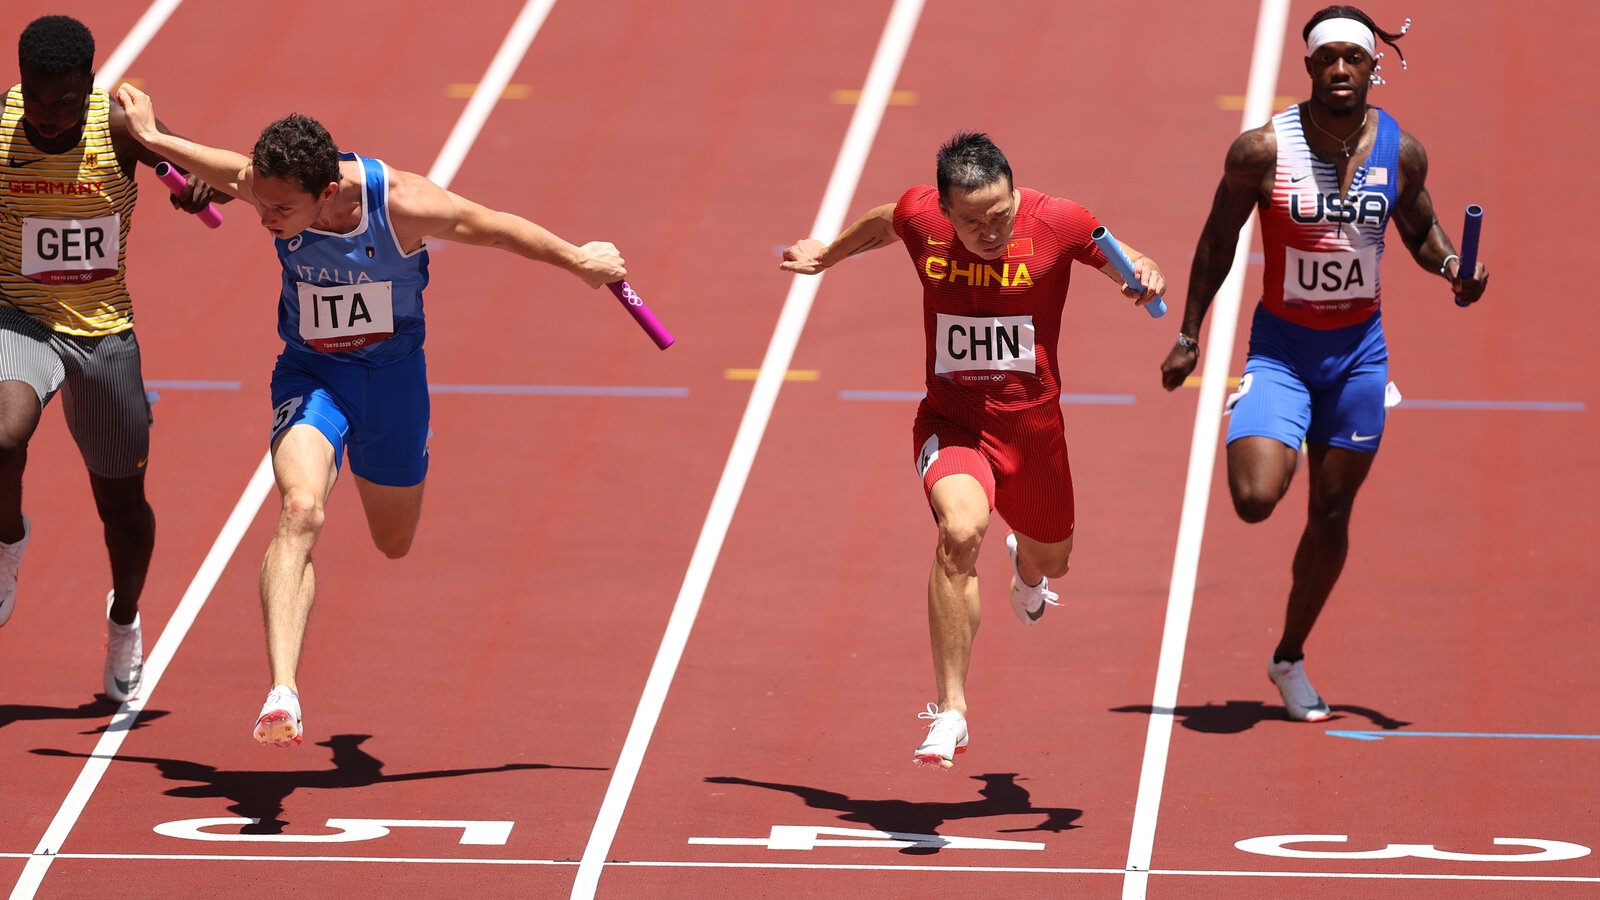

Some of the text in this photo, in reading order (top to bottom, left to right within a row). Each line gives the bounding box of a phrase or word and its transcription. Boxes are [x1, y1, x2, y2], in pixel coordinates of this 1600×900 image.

[9, 180, 104, 195] GERMANY
[1290, 192, 1388, 225] USA
[37, 226, 105, 262] GER
[296, 264, 373, 284] ITALIA
[925, 255, 1034, 287] CHINA
[1298, 258, 1364, 292] USA
[312, 292, 372, 329] ITA
[947, 324, 1020, 361] CHN
[273, 401, 292, 432] 5
[153, 817, 515, 845] 5
[688, 825, 1046, 850] 4
[1234, 834, 1592, 862] 3
